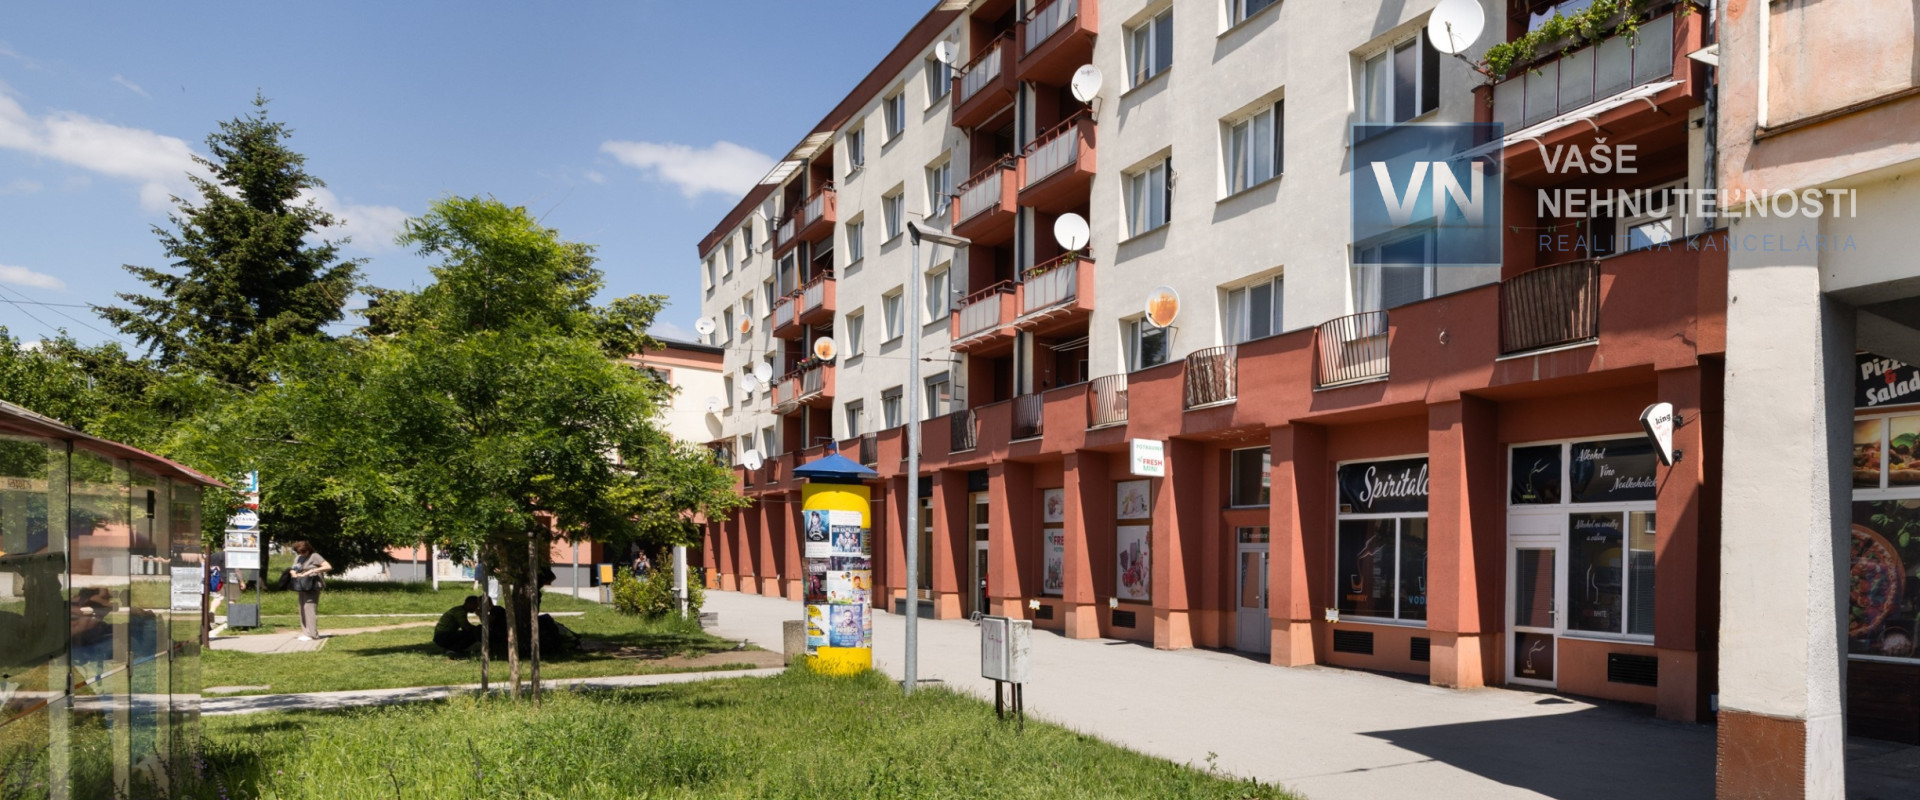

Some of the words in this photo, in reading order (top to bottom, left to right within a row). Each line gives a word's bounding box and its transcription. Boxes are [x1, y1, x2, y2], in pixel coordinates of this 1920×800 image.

[1861, 358, 1907, 380] Pizz
[1884, 368, 1897, 384] &
[1655, 413, 1671, 425] king
[1576, 448, 1606, 461] Alkohol
[1142, 458, 1162, 467] FRESH
[1408, 594, 1427, 605] VOD
